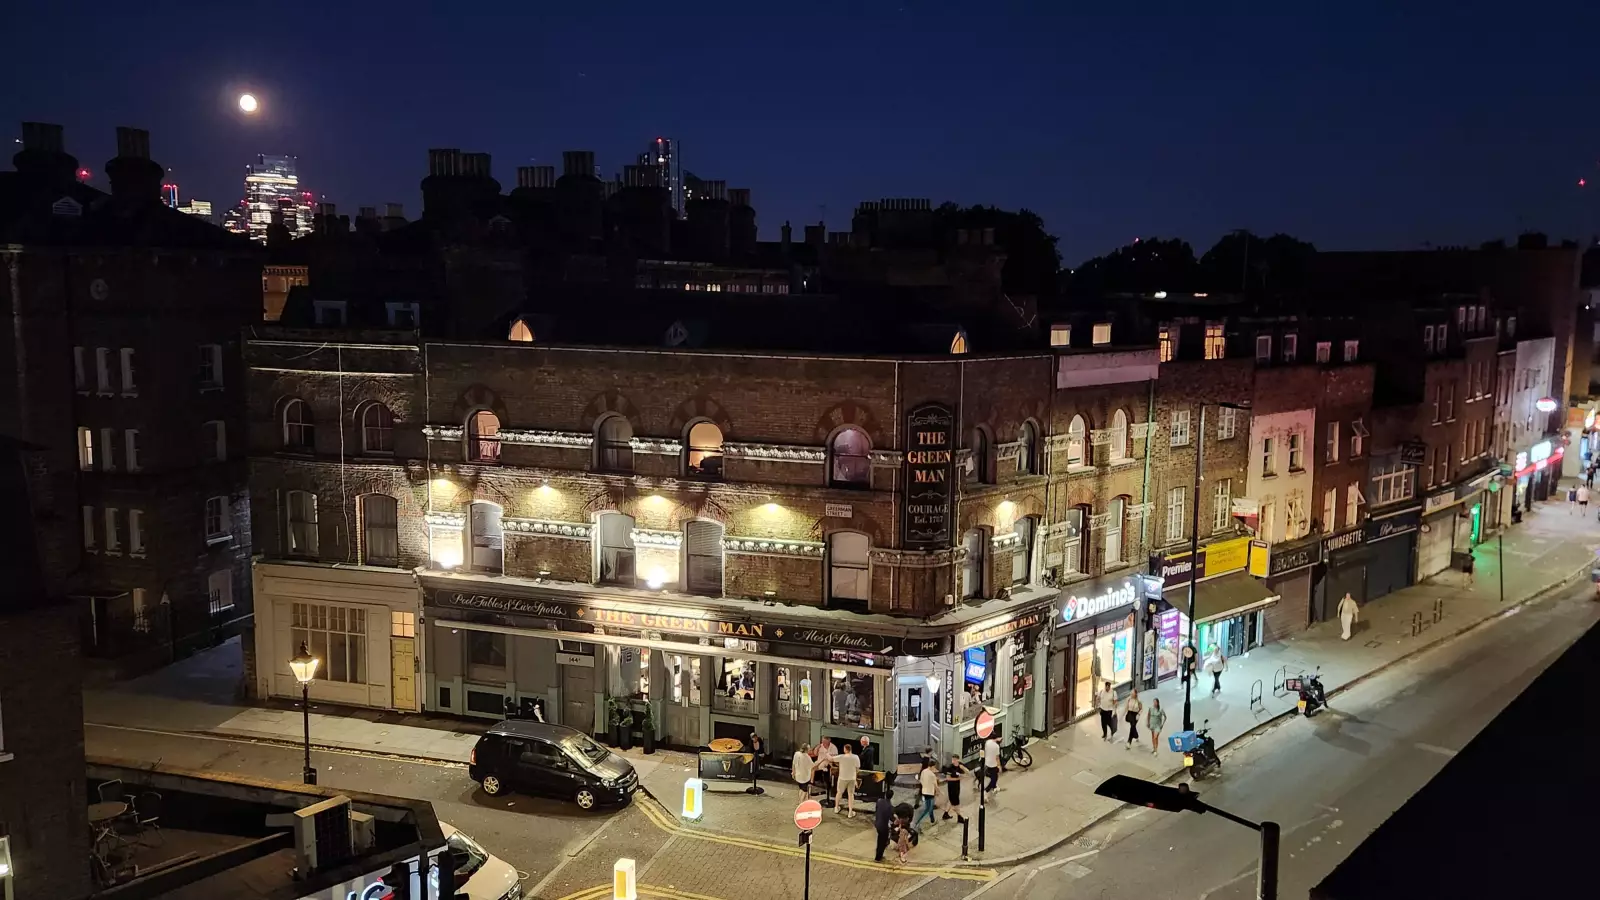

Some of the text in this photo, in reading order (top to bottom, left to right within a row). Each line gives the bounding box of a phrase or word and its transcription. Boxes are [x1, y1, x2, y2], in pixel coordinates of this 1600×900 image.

[917, 432, 946, 445] THE
[907, 450, 951, 464] GREEN
[914, 469, 945, 483] MAN
[908, 504, 949, 514] COURAGE
[914, 515, 928, 524] Est.
[1162, 562, 1192, 577] Premier
[450, 593, 567, 616] Pool Tables & Live Sports
[1076, 582, 1136, 619] Domino's
[594, 609, 764, 638] THE GREEN MAN
[985, 620, 1018, 637] GREEN
[1020, 614, 1039, 626] MAN
[794, 629, 872, 648] Ales & Stouts
[1016, 643, 1025, 651] LAY
